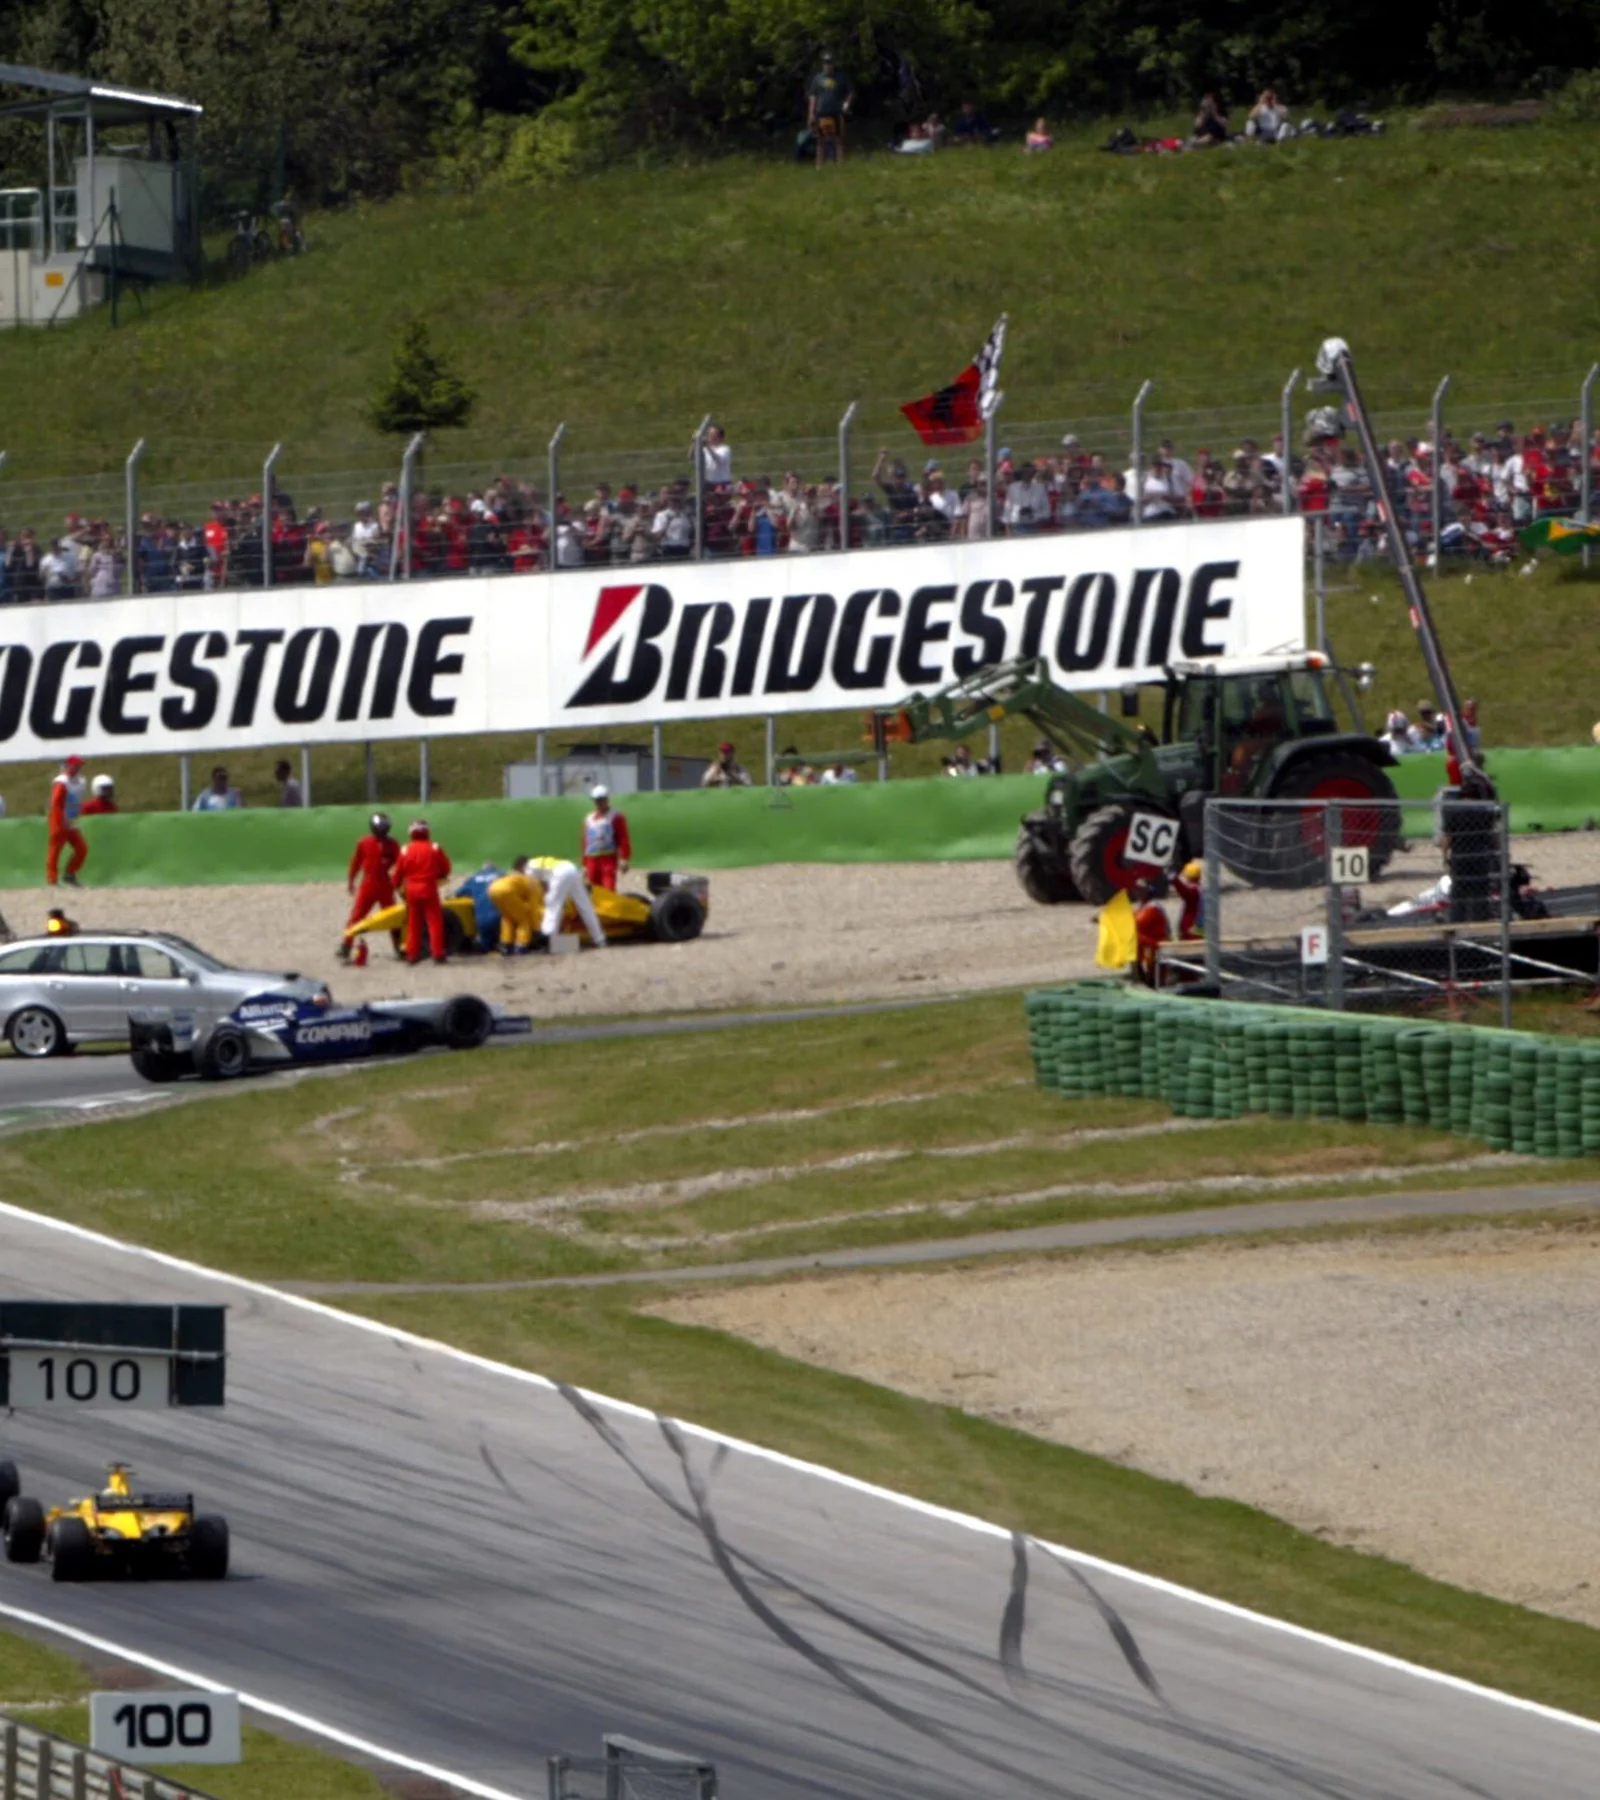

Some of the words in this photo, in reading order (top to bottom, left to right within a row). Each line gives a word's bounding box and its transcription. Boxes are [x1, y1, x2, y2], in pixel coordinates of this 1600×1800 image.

[564, 559, 1240, 709] BRIDGESTONE
[1130, 819, 1173, 858] SC
[1334, 855, 1365, 877] 10
[1309, 934, 1322, 956] F
[38, 1357, 140, 1401] 100
[114, 1703, 211, 1748] 100
